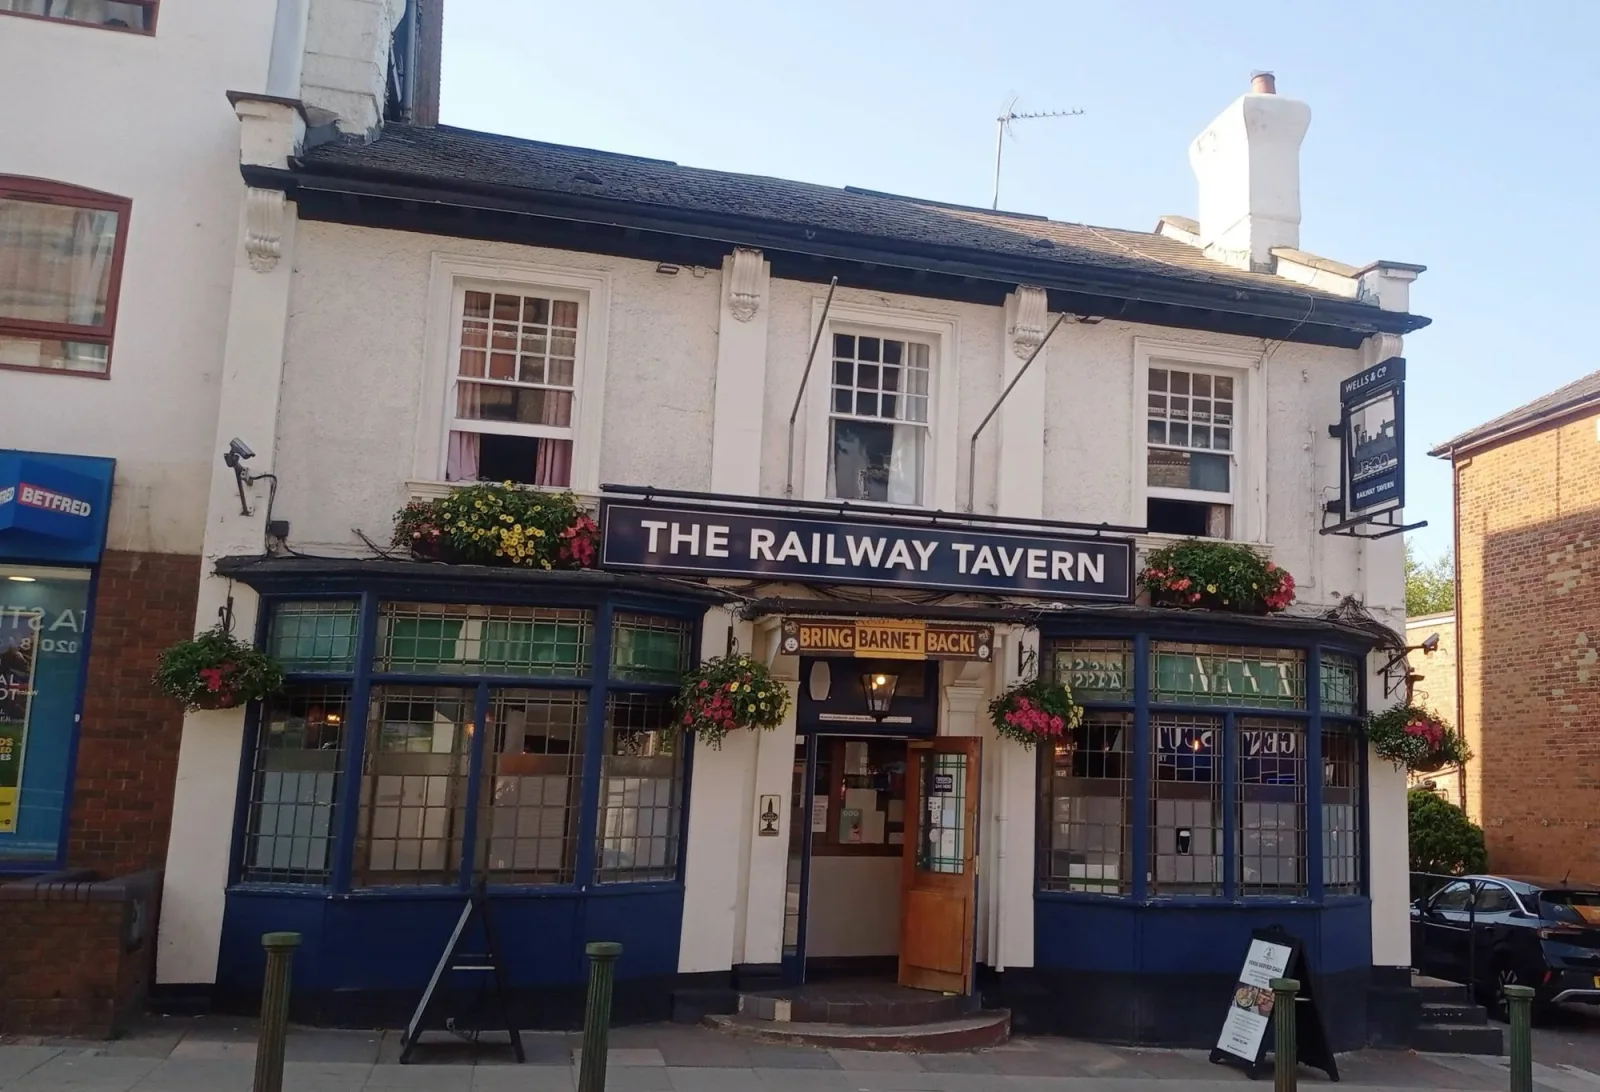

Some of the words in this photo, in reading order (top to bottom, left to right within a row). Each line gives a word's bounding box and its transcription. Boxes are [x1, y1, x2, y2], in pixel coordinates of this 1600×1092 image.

[1345, 374, 1370, 393] WELLS
[1370, 371, 1376, 382] &
[21, 486, 92, 517] BETFRED
[1356, 487, 1375, 500] RAILWAY
[1376, 481, 1395, 492] TAVERN
[641, 519, 730, 558] THE
[750, 528, 939, 571] RAILWAY
[951, 543, 1104, 583] TAVERN
[800, 627, 853, 648] BRING
[859, 629, 922, 650] BARNET
[927, 632, 976, 652] BACK!
